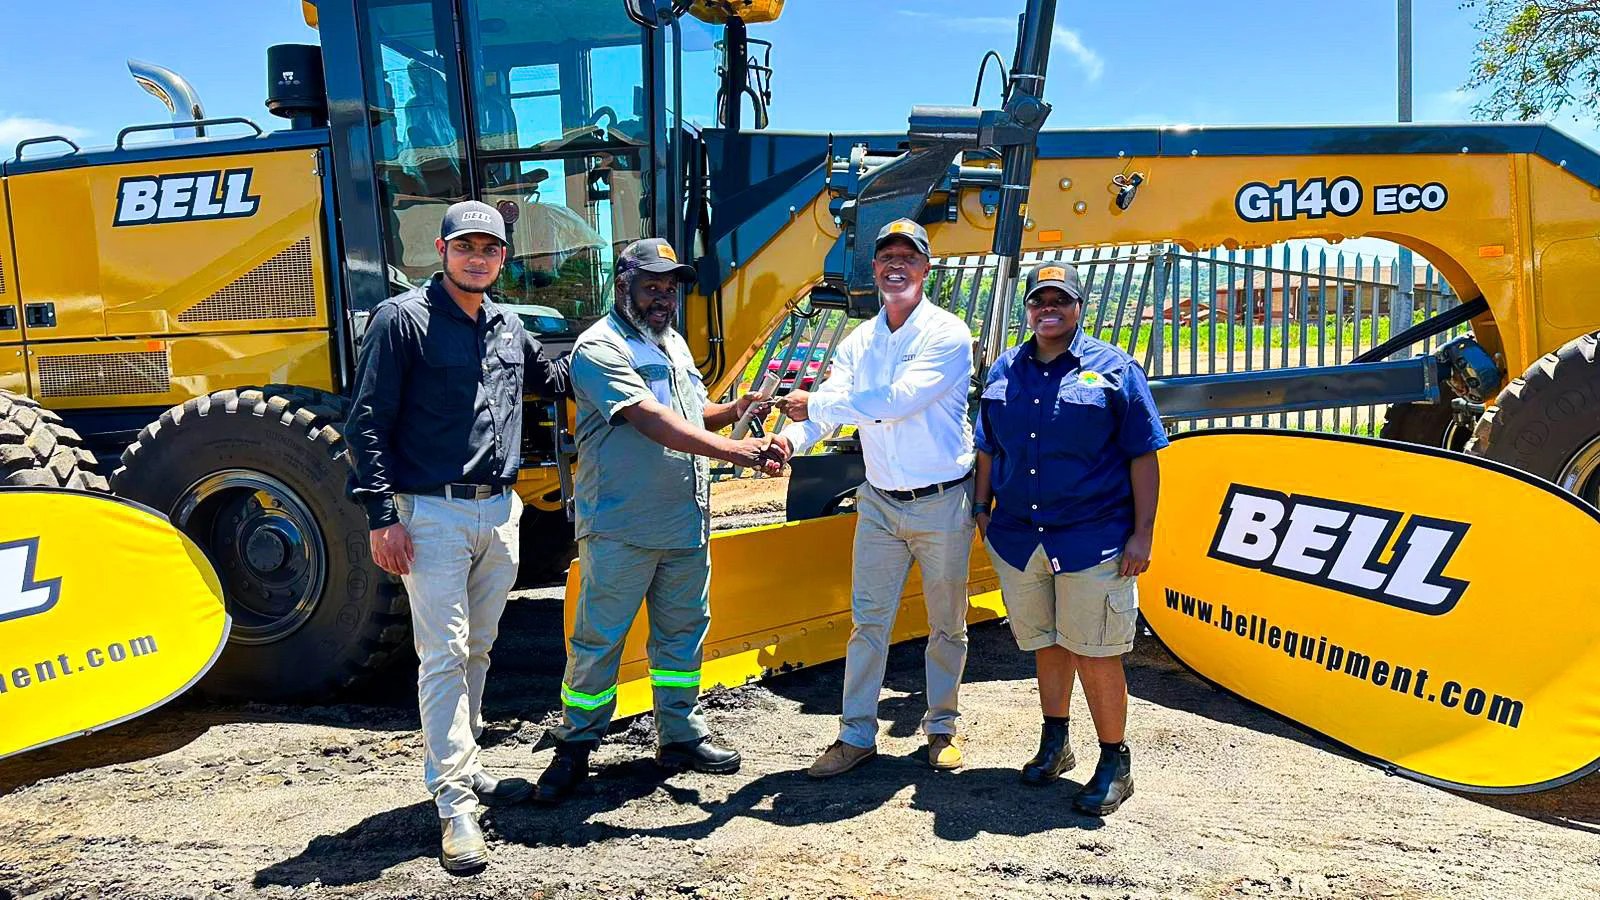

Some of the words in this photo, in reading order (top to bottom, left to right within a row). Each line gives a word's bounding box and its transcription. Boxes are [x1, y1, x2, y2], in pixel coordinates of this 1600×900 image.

[114, 169, 259, 225] BELL
[463, 212, 491, 222] BELL
[1237, 177, 1361, 221] G140
[1375, 183, 1447, 214] ECO
[1210, 485, 1468, 612] BELL
[1165, 588, 1524, 728] www.bellequipment.com
